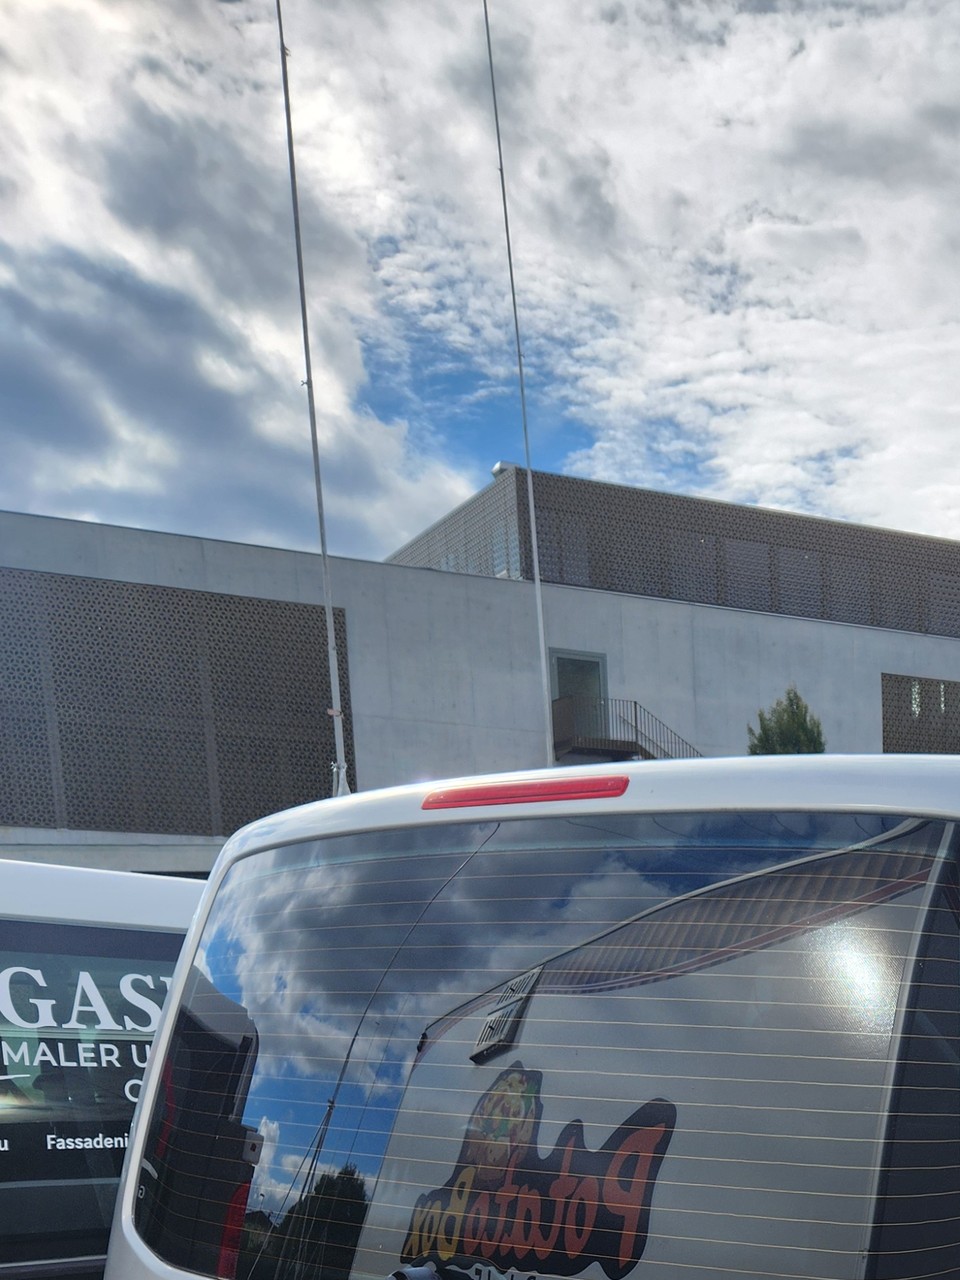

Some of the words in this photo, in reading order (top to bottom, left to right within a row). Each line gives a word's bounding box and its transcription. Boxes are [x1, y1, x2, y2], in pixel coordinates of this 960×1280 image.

[0, 967, 172, 1032] GAS
[1, 1041, 122, 1068] MALER
[46, 1133, 129, 1150] Fassadeni
